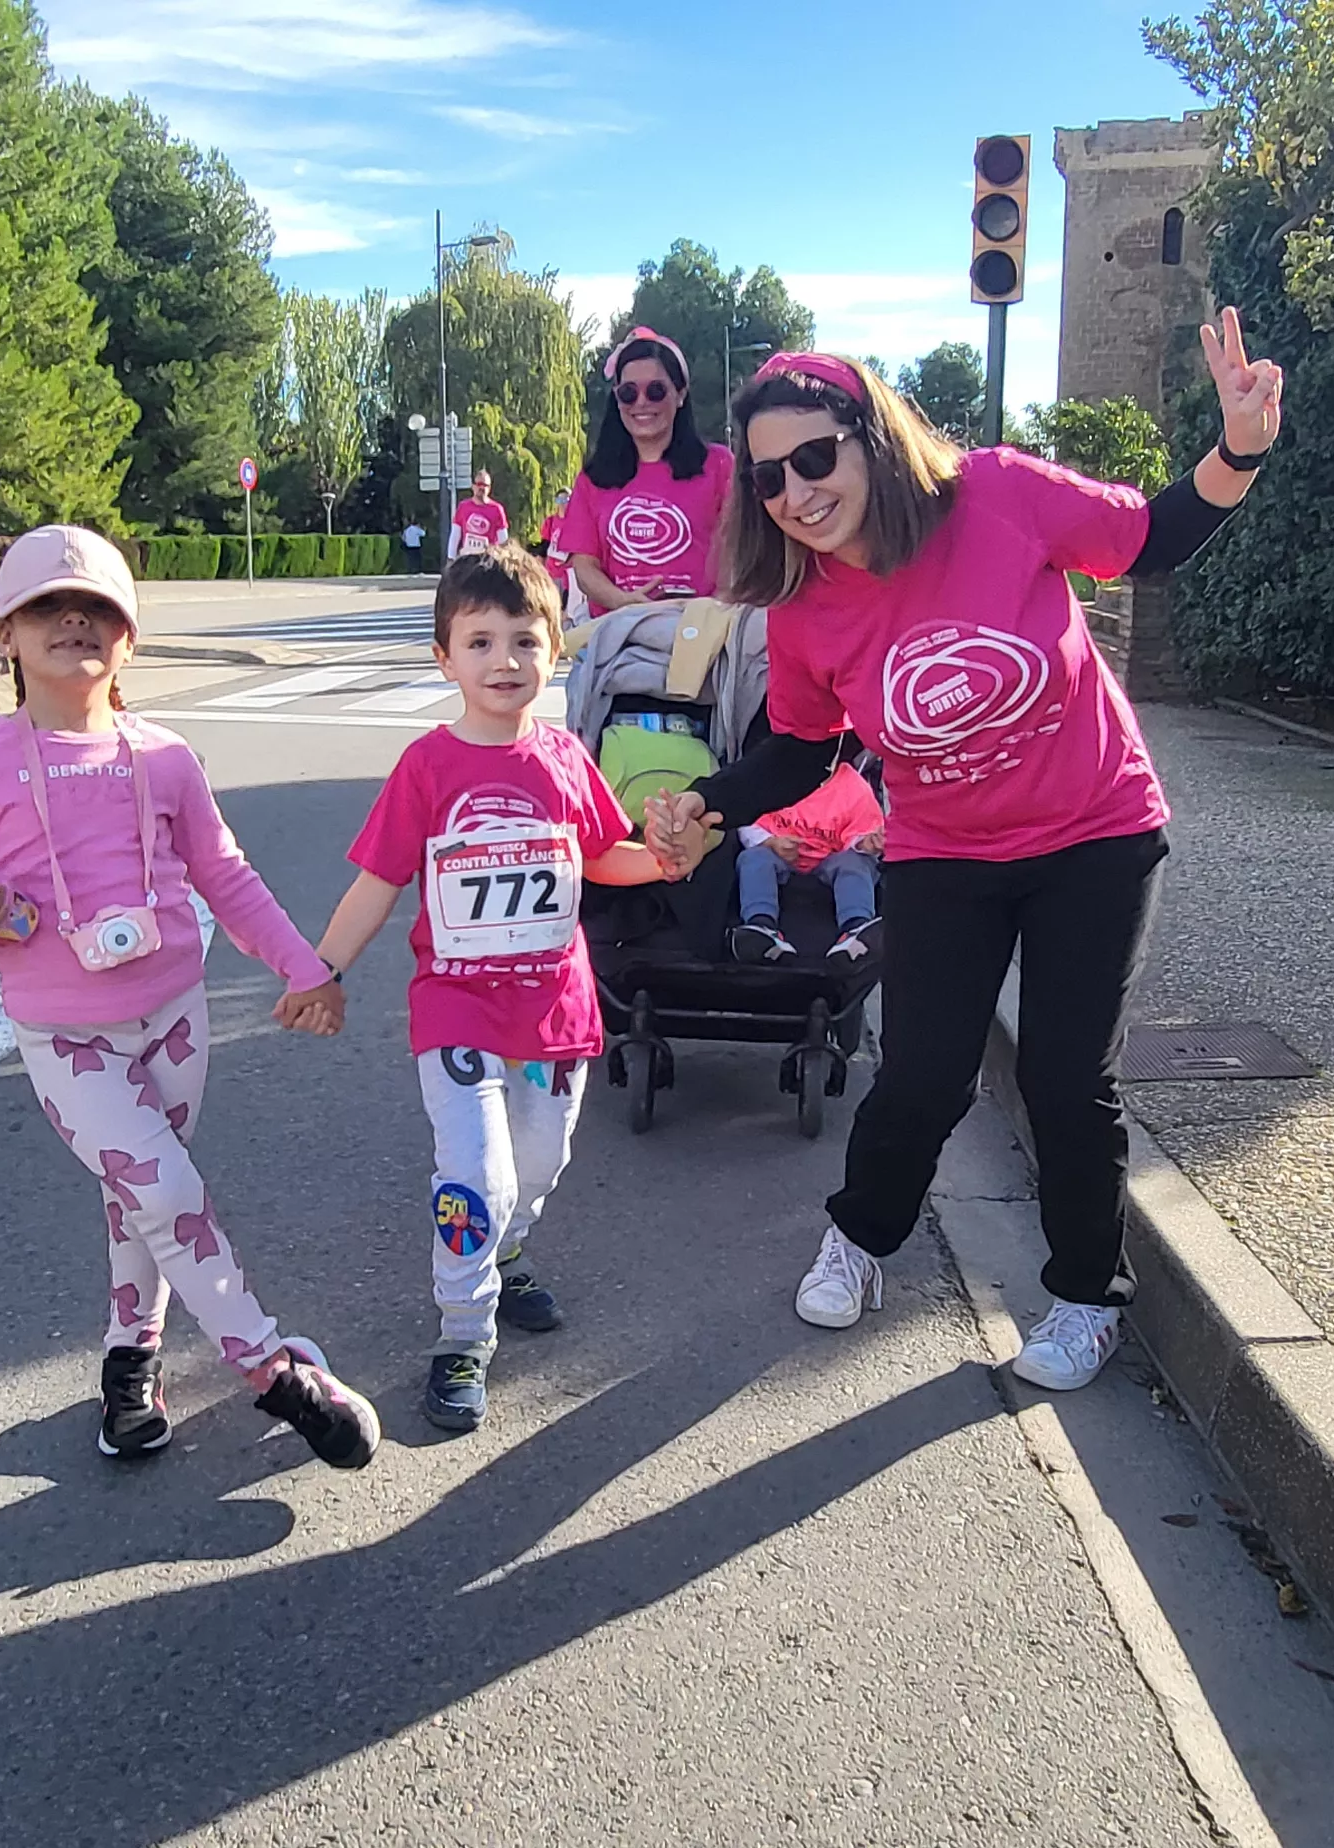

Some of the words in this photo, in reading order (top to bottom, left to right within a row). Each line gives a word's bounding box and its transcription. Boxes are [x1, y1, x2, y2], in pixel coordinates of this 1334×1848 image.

[488, 842, 528, 854] HUESCA
[443, 856, 500, 871] CONTRA
[503, 853, 518, 865] EL
[521, 849, 567, 864] CÁNCER
[460, 870, 559, 920] 772
